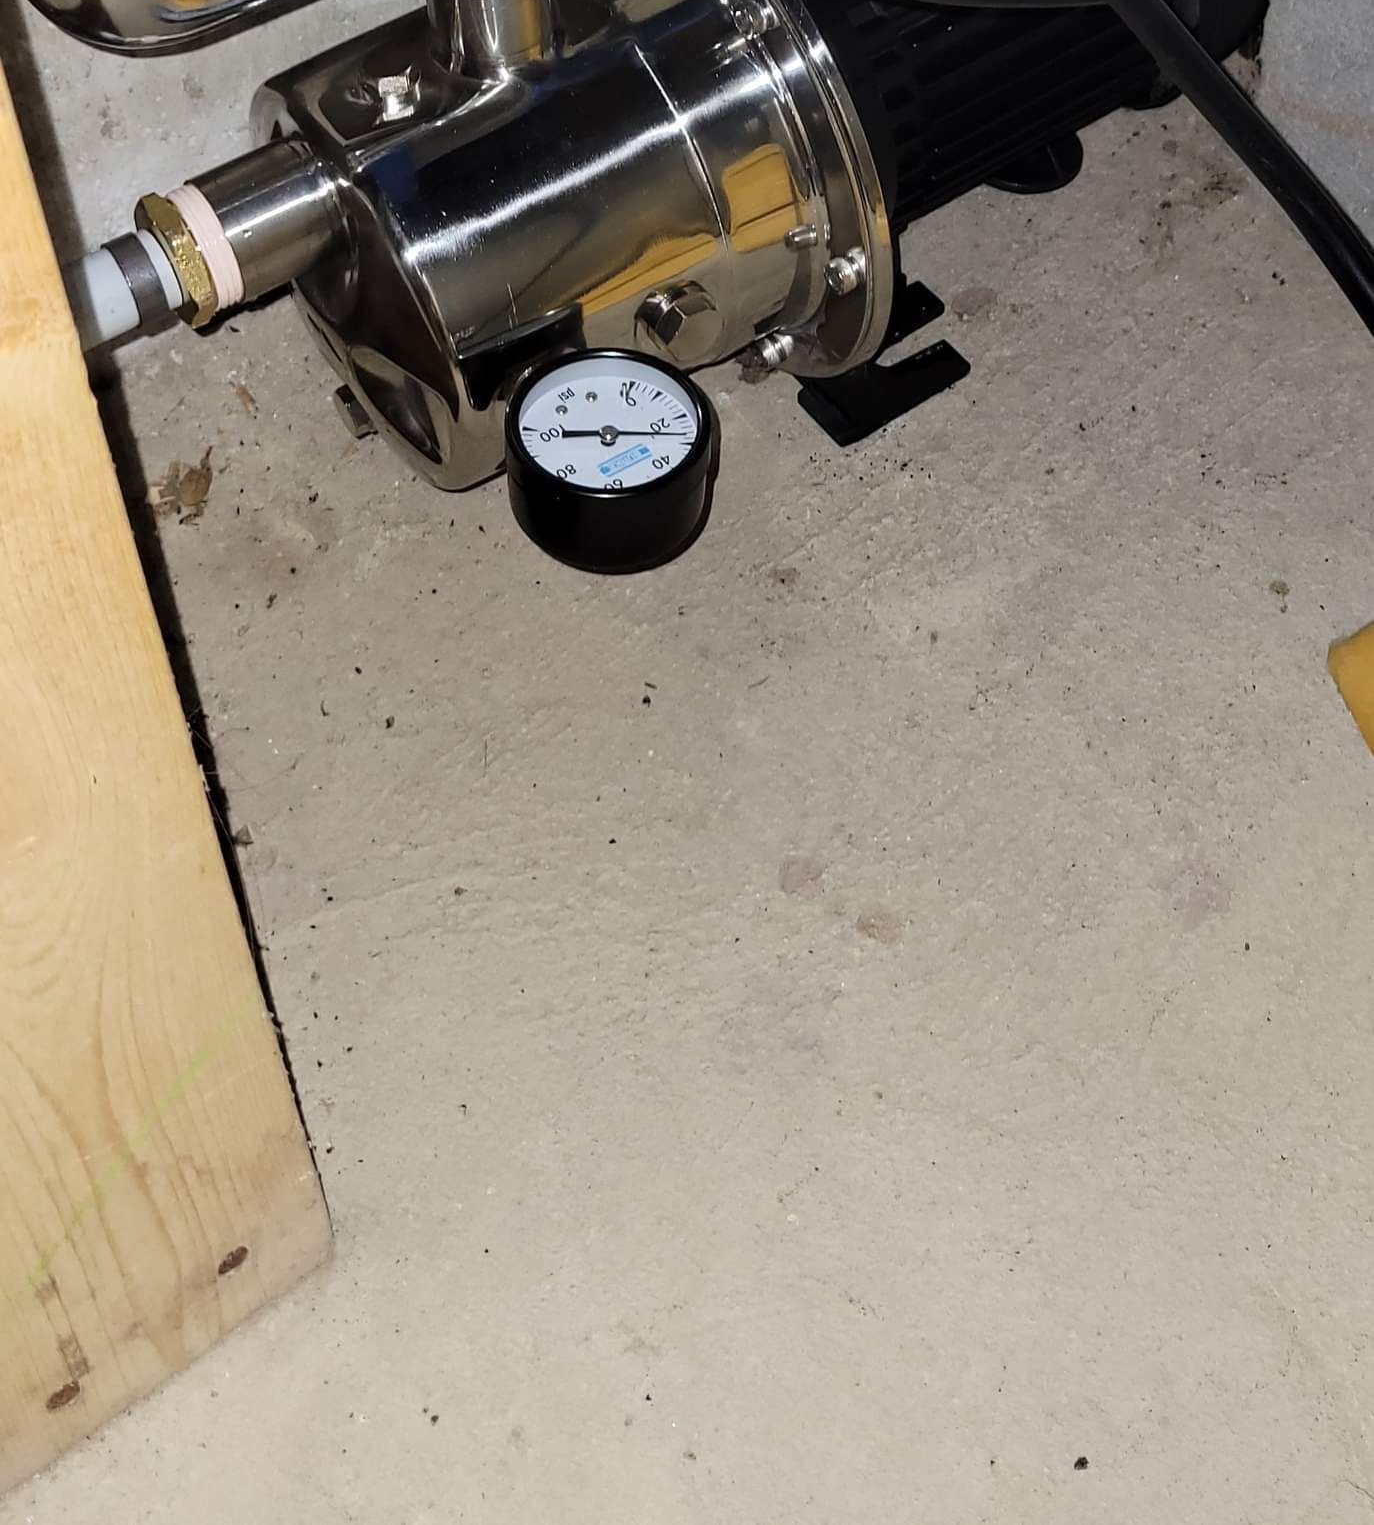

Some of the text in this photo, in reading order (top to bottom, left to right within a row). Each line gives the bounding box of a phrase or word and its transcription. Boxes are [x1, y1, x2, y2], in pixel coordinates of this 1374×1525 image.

[557, 386, 577, 404] psi
[649, 417, 671, 434] 20
[652, 454, 671, 470] 40
[556, 463, 577, 480] 80
